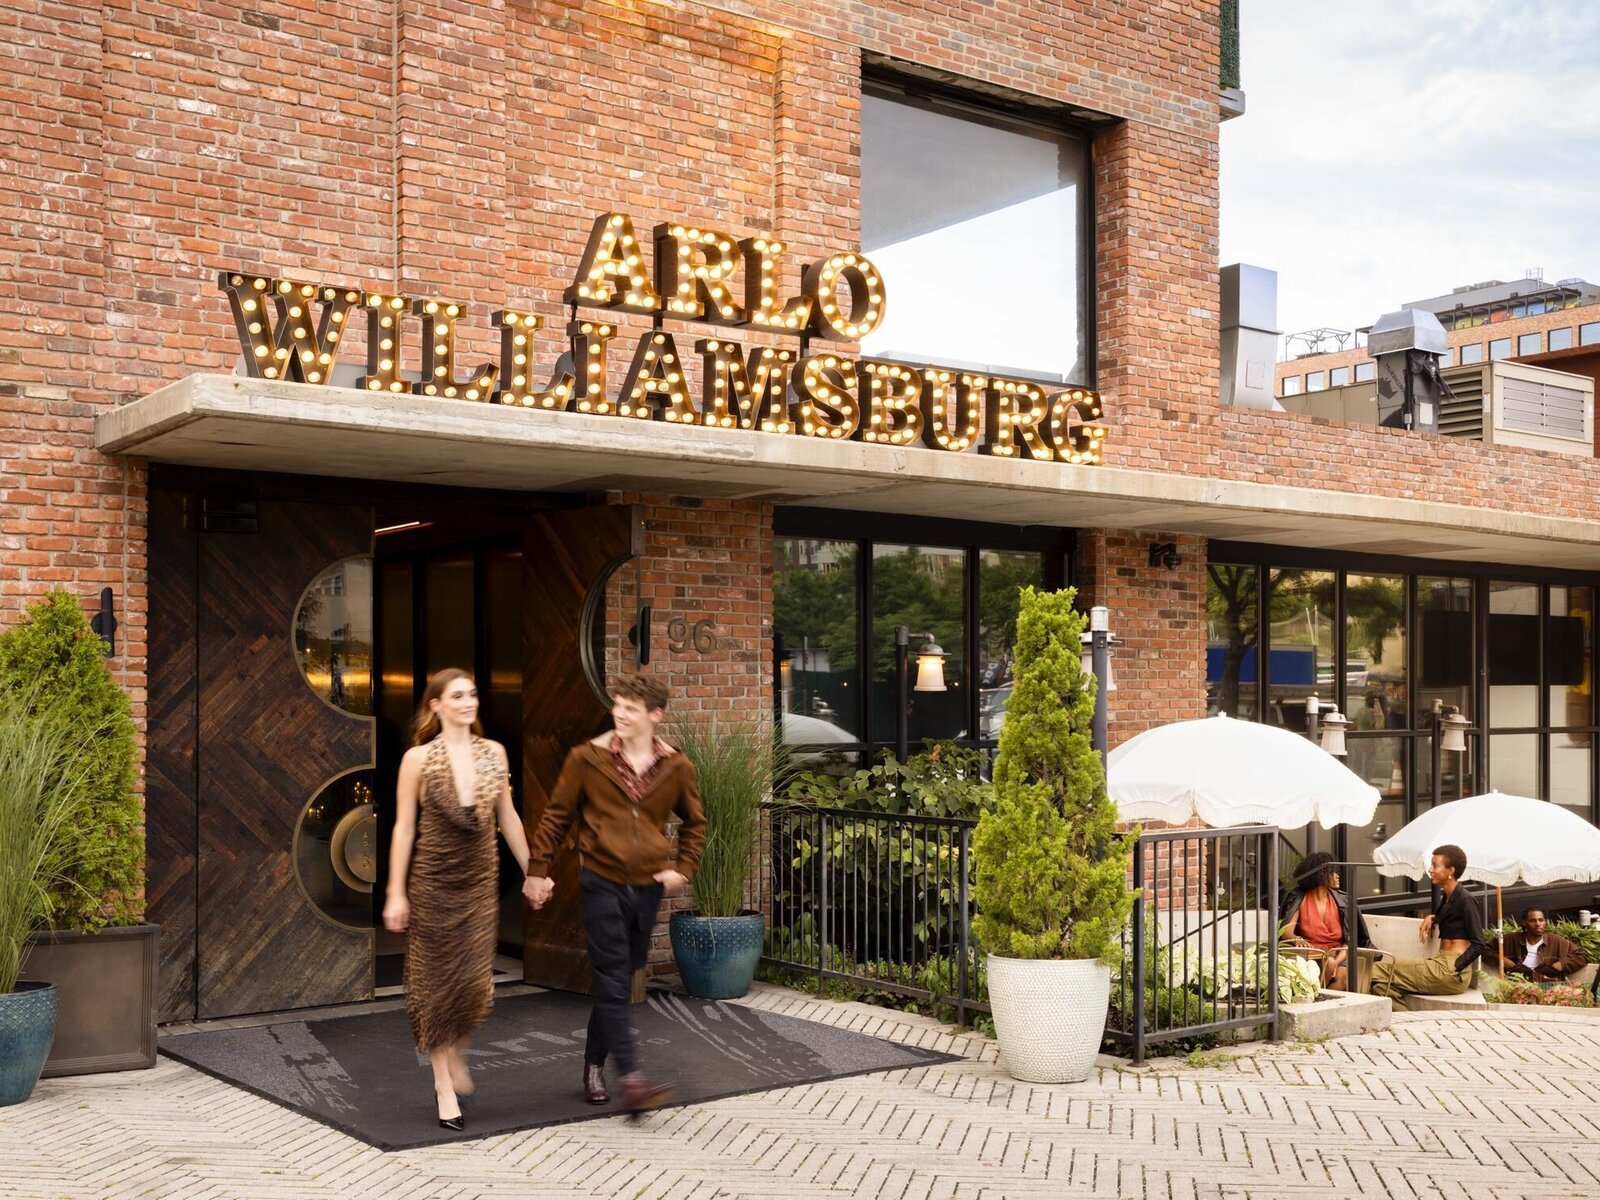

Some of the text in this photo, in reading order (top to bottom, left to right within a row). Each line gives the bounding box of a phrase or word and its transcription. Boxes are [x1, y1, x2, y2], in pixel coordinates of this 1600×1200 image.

[564, 211, 886, 341] ARLO
[219, 271, 1108, 466] WILLIAMSBURG
[668, 617, 718, 654] 96
